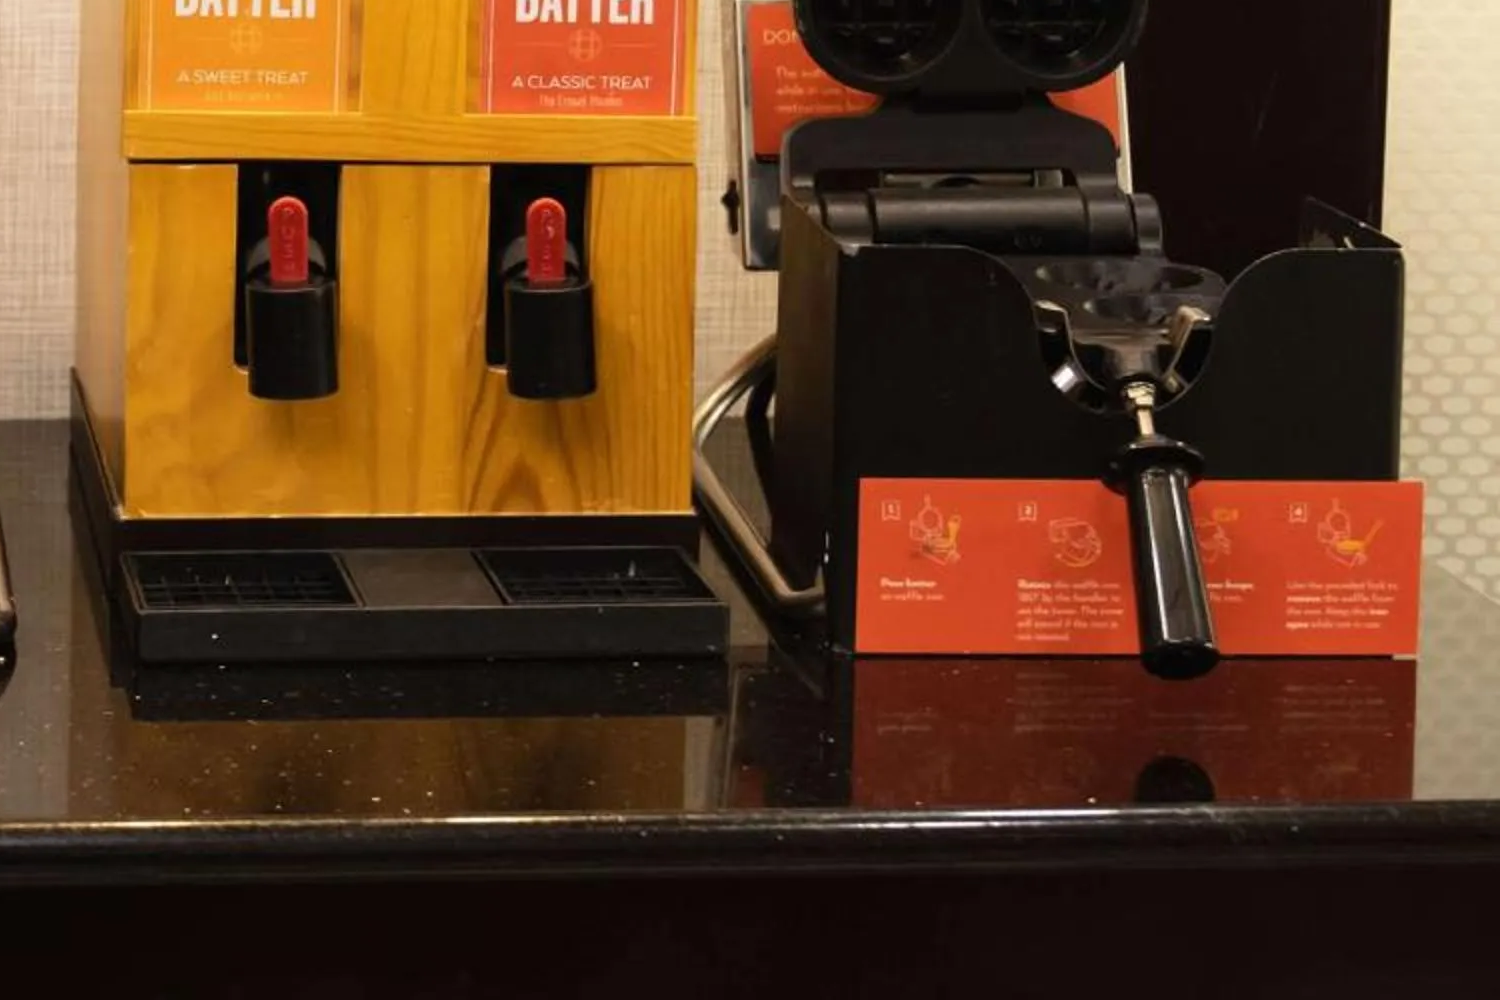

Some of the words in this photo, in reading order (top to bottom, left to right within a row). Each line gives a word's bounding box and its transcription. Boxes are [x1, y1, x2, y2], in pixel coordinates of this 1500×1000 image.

[177, 69, 190, 83] A
[192, 69, 250, 85] SWEET
[257, 70, 308, 86] TREAT
[511, 75, 524, 89] A
[527, 75, 597, 89] CLASSIC
[601, 75, 651, 90] TREAT
